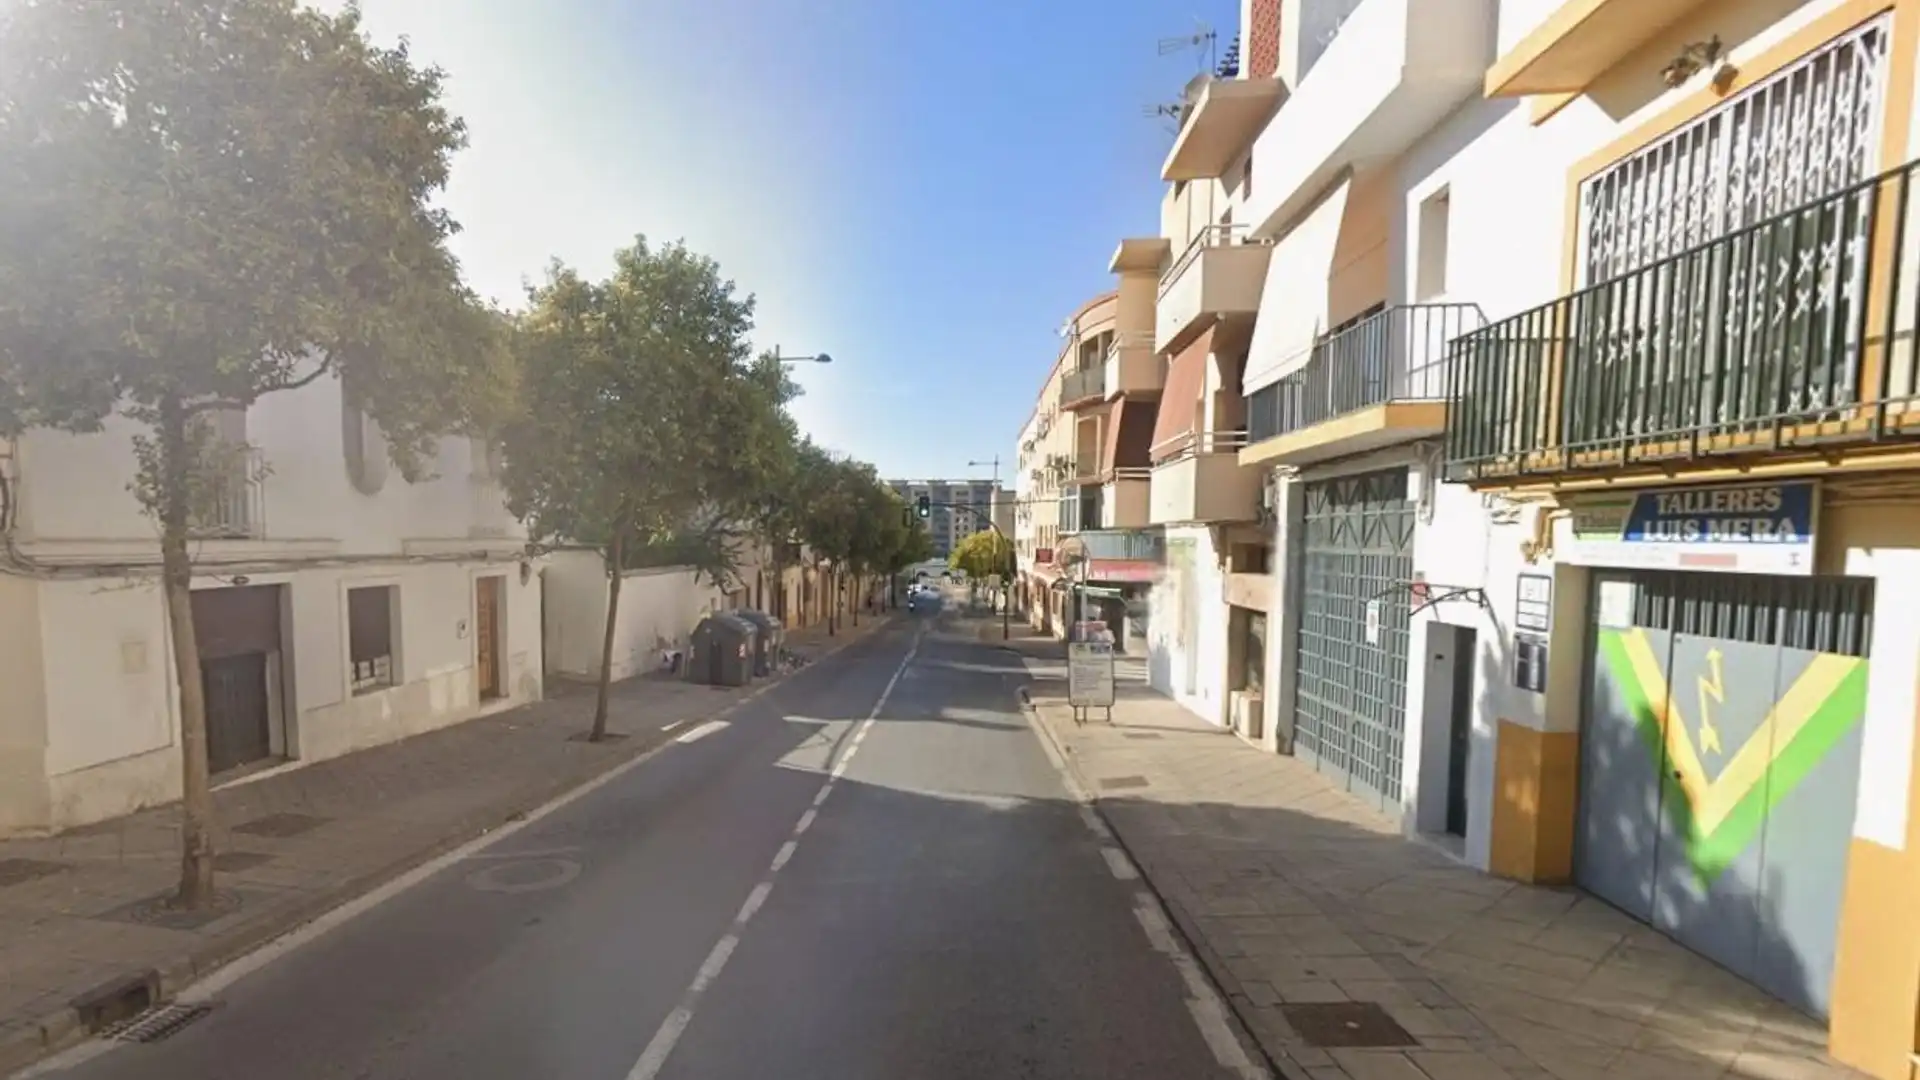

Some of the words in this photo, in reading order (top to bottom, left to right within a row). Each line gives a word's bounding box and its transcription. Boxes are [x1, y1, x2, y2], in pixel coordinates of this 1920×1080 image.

[1655, 487, 1782, 515] TALLERES
[1642, 518, 1700, 542] LUIS
[1705, 517, 1798, 543] MERA
